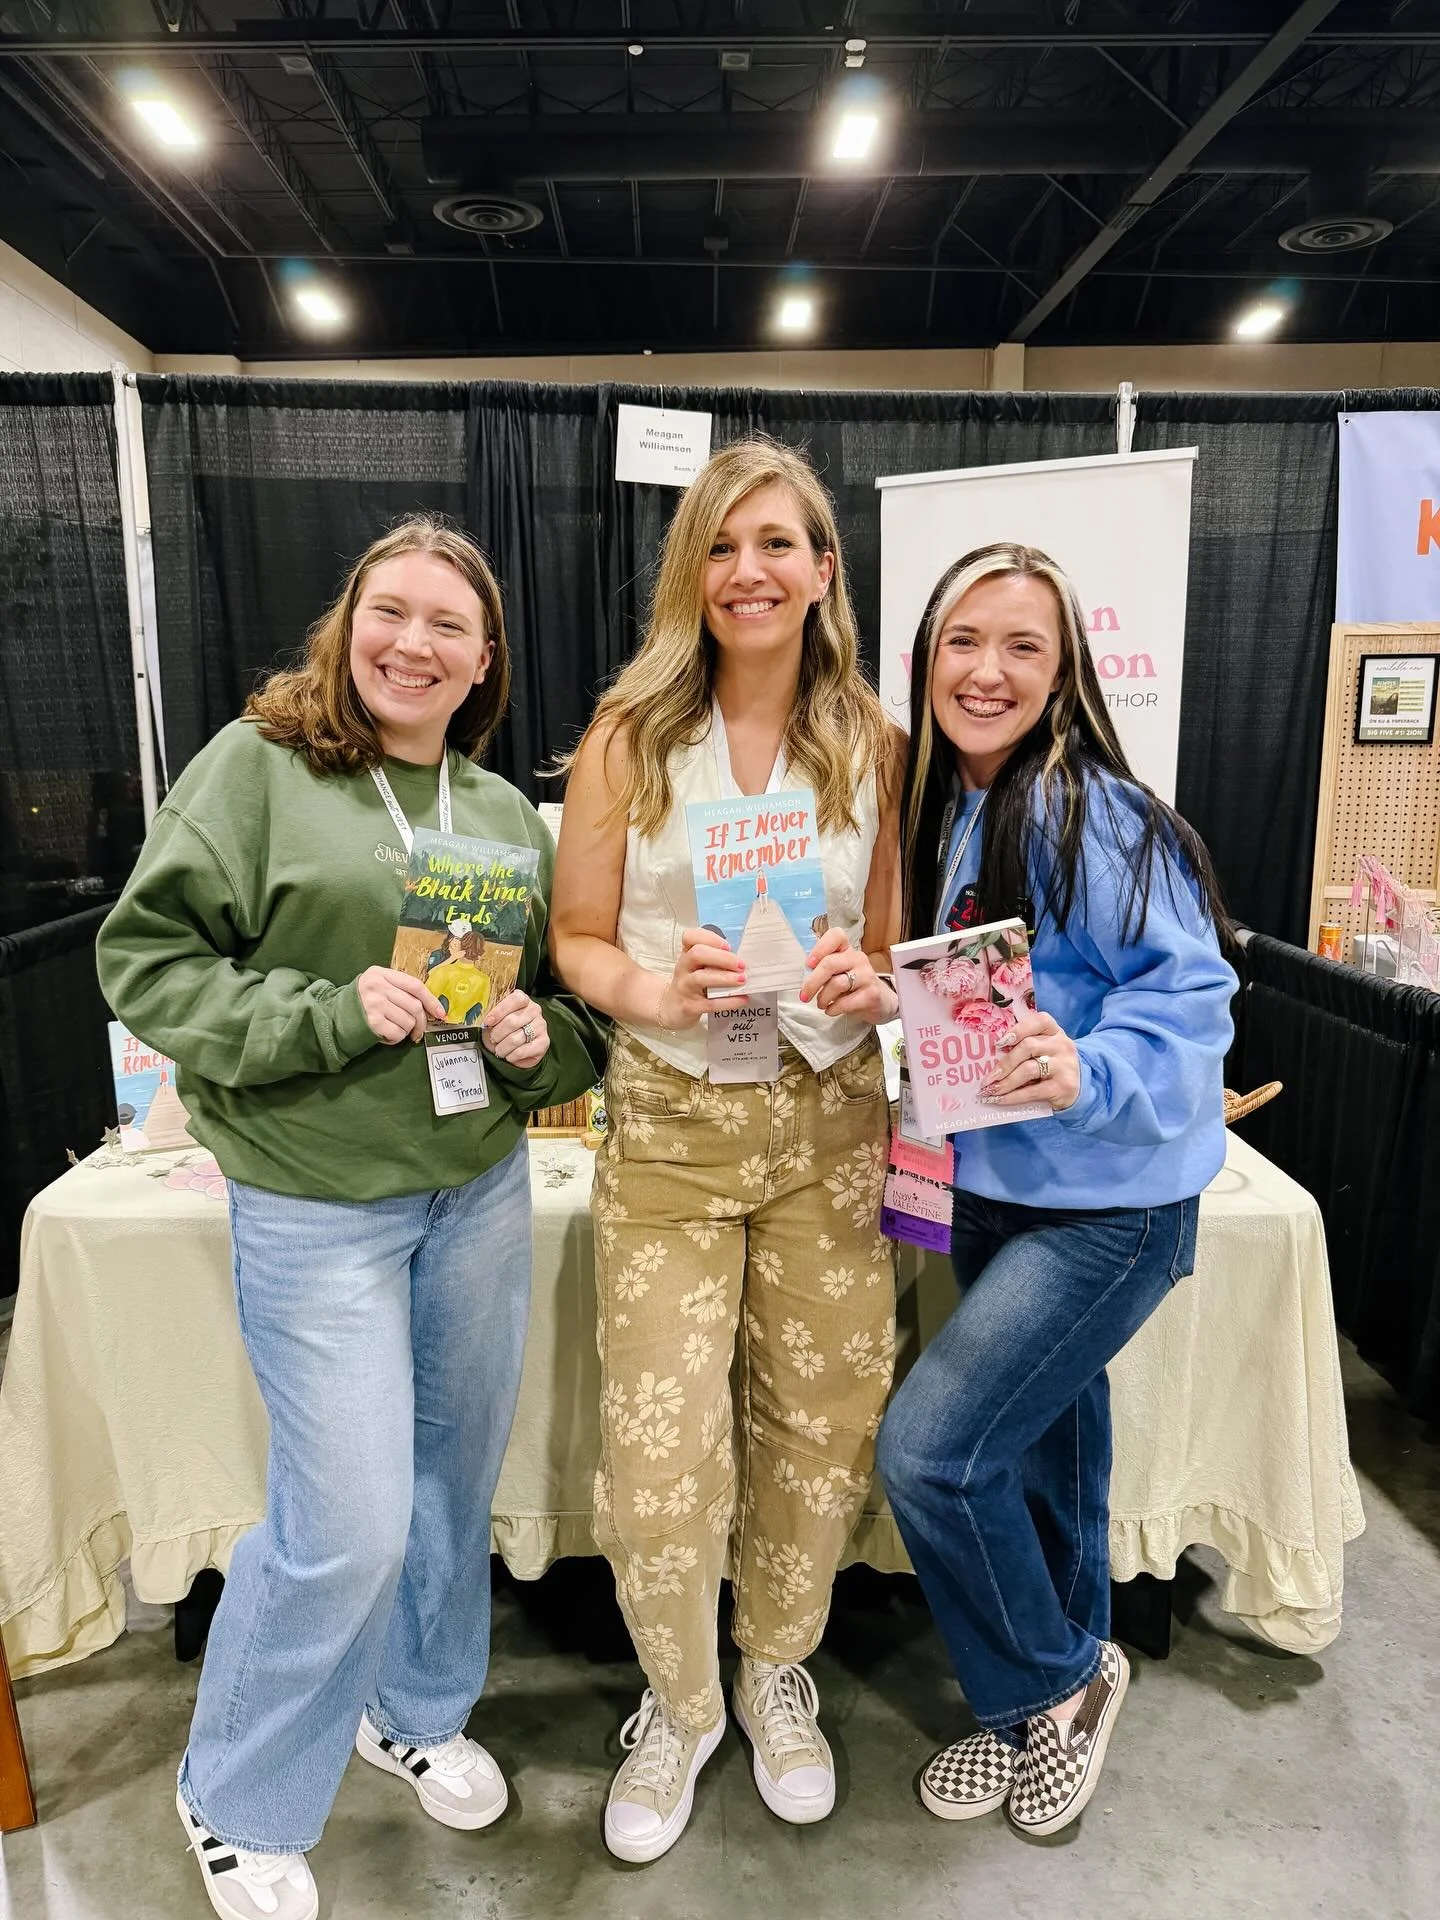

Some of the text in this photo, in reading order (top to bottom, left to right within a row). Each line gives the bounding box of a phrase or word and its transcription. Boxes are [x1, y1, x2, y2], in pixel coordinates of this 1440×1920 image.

[645, 428, 684, 440] Meagan
[639, 441, 692, 454] Williamson
[1105, 692, 1159, 709] THOR
[704, 798, 801, 817] MEAGAN WILLIAMSON
[704, 810, 809, 849] If I Never
[430, 836, 528, 862] MEAGAN WILLIAMSON
[428, 855, 514, 880] Where the
[705, 835, 811, 883] Remember
[416, 876, 528, 903] Black Line
[445, 905, 493, 925] Ends
[713, 1007, 772, 1018] ROMANCE
[732, 1018, 756, 1031] out
[918, 1024, 942, 1039] THE
[435, 1031, 470, 1043] VENDOR
[727, 1032, 760, 1043] WEST
[919, 1032, 1010, 1069] SOUN
[437, 1077, 456, 1090] Tale
[927, 1073, 943, 1087] OF
[935, 1115, 977, 1131] MEAGAN
[979, 1104, 1042, 1122] WILLIAMSON
[892, 1198, 942, 1220] VALENTINE
